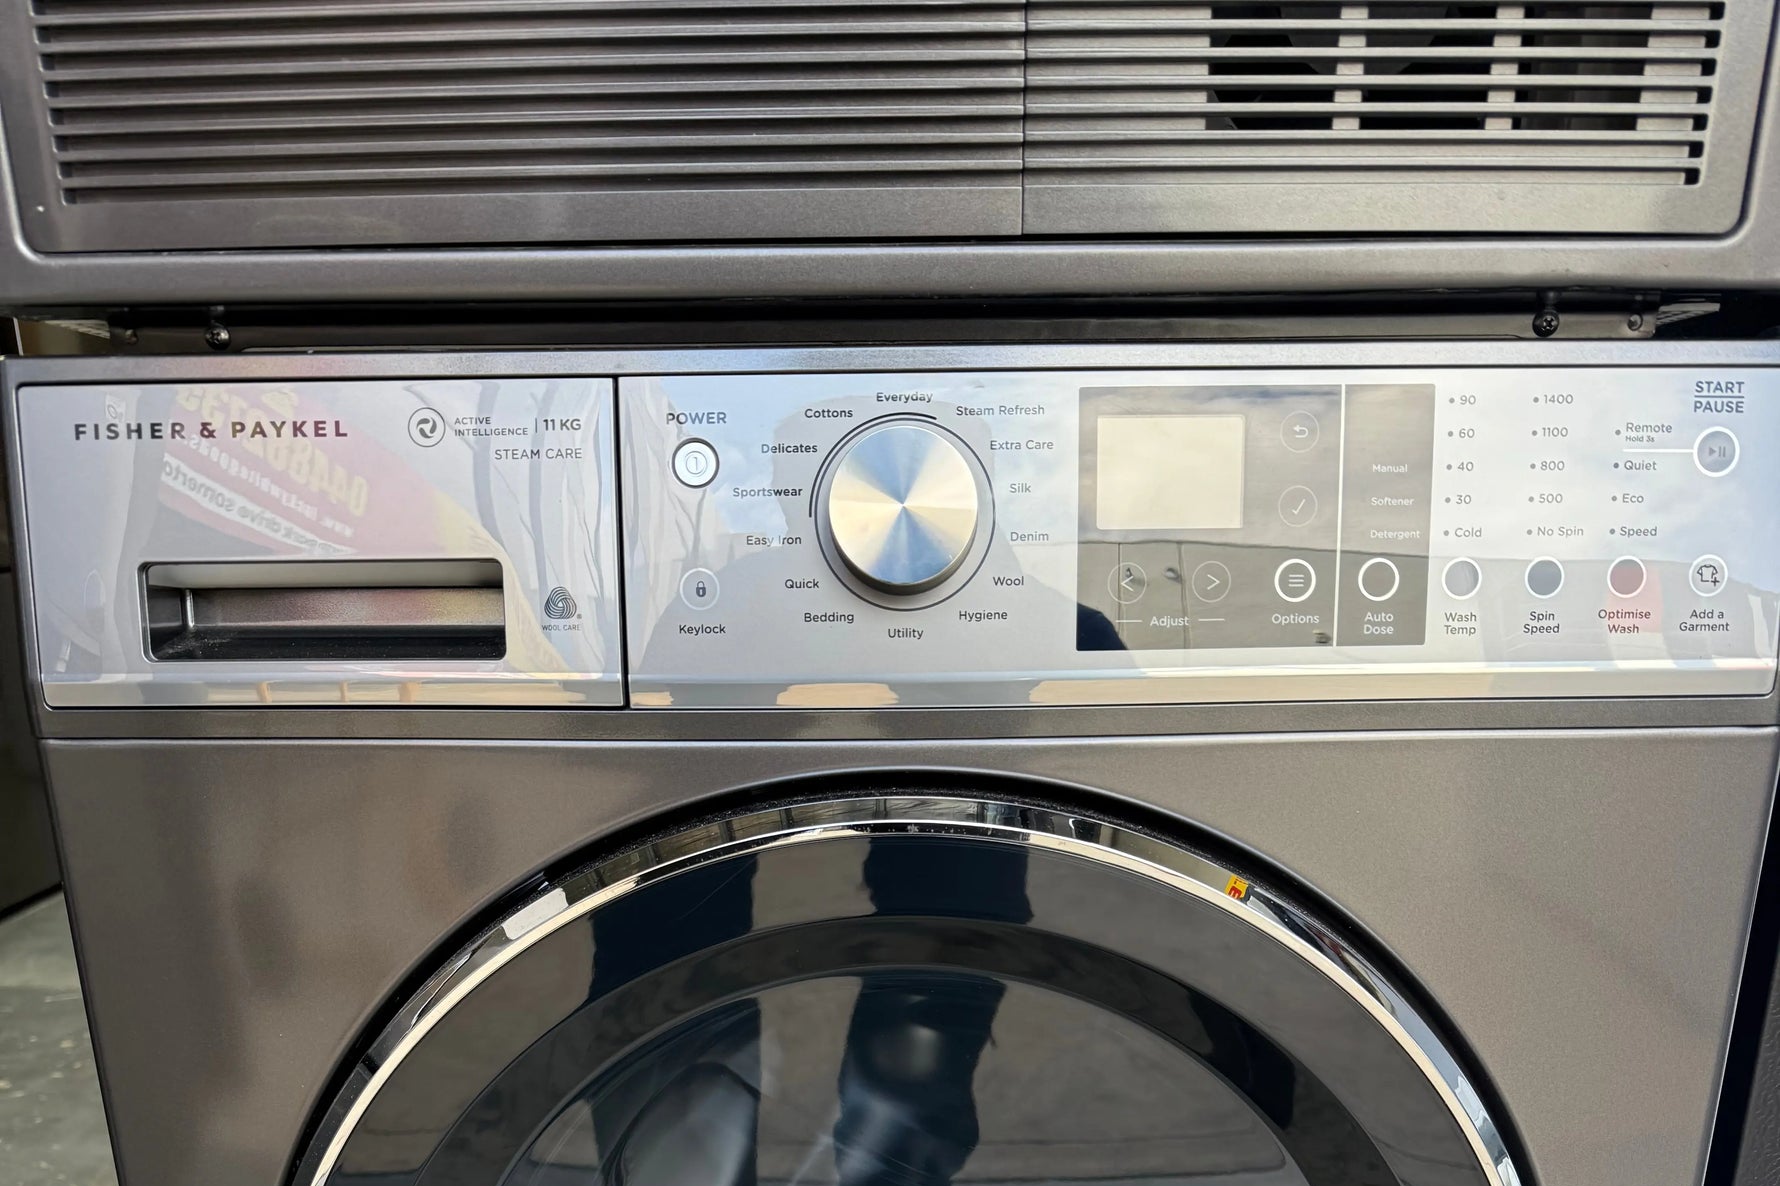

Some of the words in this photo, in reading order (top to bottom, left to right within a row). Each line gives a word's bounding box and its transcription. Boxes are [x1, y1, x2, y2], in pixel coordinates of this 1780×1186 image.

[1695, 381, 1745, 394] START
[875, 392, 933, 403] Everyday
[1459, 395, 1476, 405] 90
[1543, 394, 1574, 405] 1400
[956, 405, 994, 416] Steam
[998, 405, 1045, 416] Refresh
[1693, 401, 1744, 413] PAUSE
[666, 411, 727, 425] POWER
[804, 408, 853, 419] Cottons
[454, 417, 491, 425] ACTIVE
[543, 418, 555, 431] 11
[560, 418, 581, 431] KG
[74, 422, 187, 440] FISHER
[200, 422, 216, 439] &
[231, 420, 348, 439] PAYKEL
[454, 428, 528, 437] INTELLIGENCE
[1458, 428, 1475, 438] 60
[1541, 427, 1568, 438] 1100
[1625, 423, 1672, 433] Remote
[1625, 435, 1643, 443] Hold
[1646, 435, 1655, 443] 3s
[761, 443, 818, 454] Delicates
[989, 439, 1023, 451] Extra
[1026, 439, 1054, 451] Care
[494, 449, 540, 460] STEAM
[545, 448, 582, 459] CARE
[1372, 464, 1408, 473] Manual
[1457, 462, 1474, 472] 40
[1540, 461, 1565, 471] 800
[1624, 460, 1657, 472] Quiet
[732, 486, 803, 499] Sportswear
[1009, 482, 1032, 494] Silk
[1371, 496, 1415, 506] Softener
[1456, 495, 1472, 505] 30
[1539, 494, 1563, 504] 500
[1622, 494, 1644, 504] Eco
[1010, 531, 1049, 542] Denim
[1370, 529, 1420, 540] Detergent
[1454, 527, 1482, 538] Cold
[1537, 527, 1554, 537] No
[1558, 527, 1584, 538] Spin
[1619, 526, 1657, 538] Speed
[746, 535, 774, 548] Easy
[778, 535, 802, 546] Iron
[784, 578, 819, 591] Quick
[993, 575, 1024, 587] Wool
[804, 612, 855, 625] Bedding
[958, 609, 1008, 623] Hygiene
[1271, 613, 1320, 625] Options
[1364, 611, 1394, 622] Auto
[1444, 611, 1477, 622] Wash
[1529, 611, 1555, 623] Spin
[1598, 609, 1651, 622] Optimise
[1689, 609, 1715, 620] Add
[1717, 612, 1725, 620] a
[1150, 615, 1189, 628] Adjust
[679, 623, 726, 636] Keylock
[1363, 624, 1394, 635] Dose
[1444, 625, 1477, 636] Temp
[1523, 623, 1560, 635] Speed
[1607, 623, 1640, 634] Wash
[1679, 622, 1730, 633] Garment
[887, 627, 924, 641] Utility
